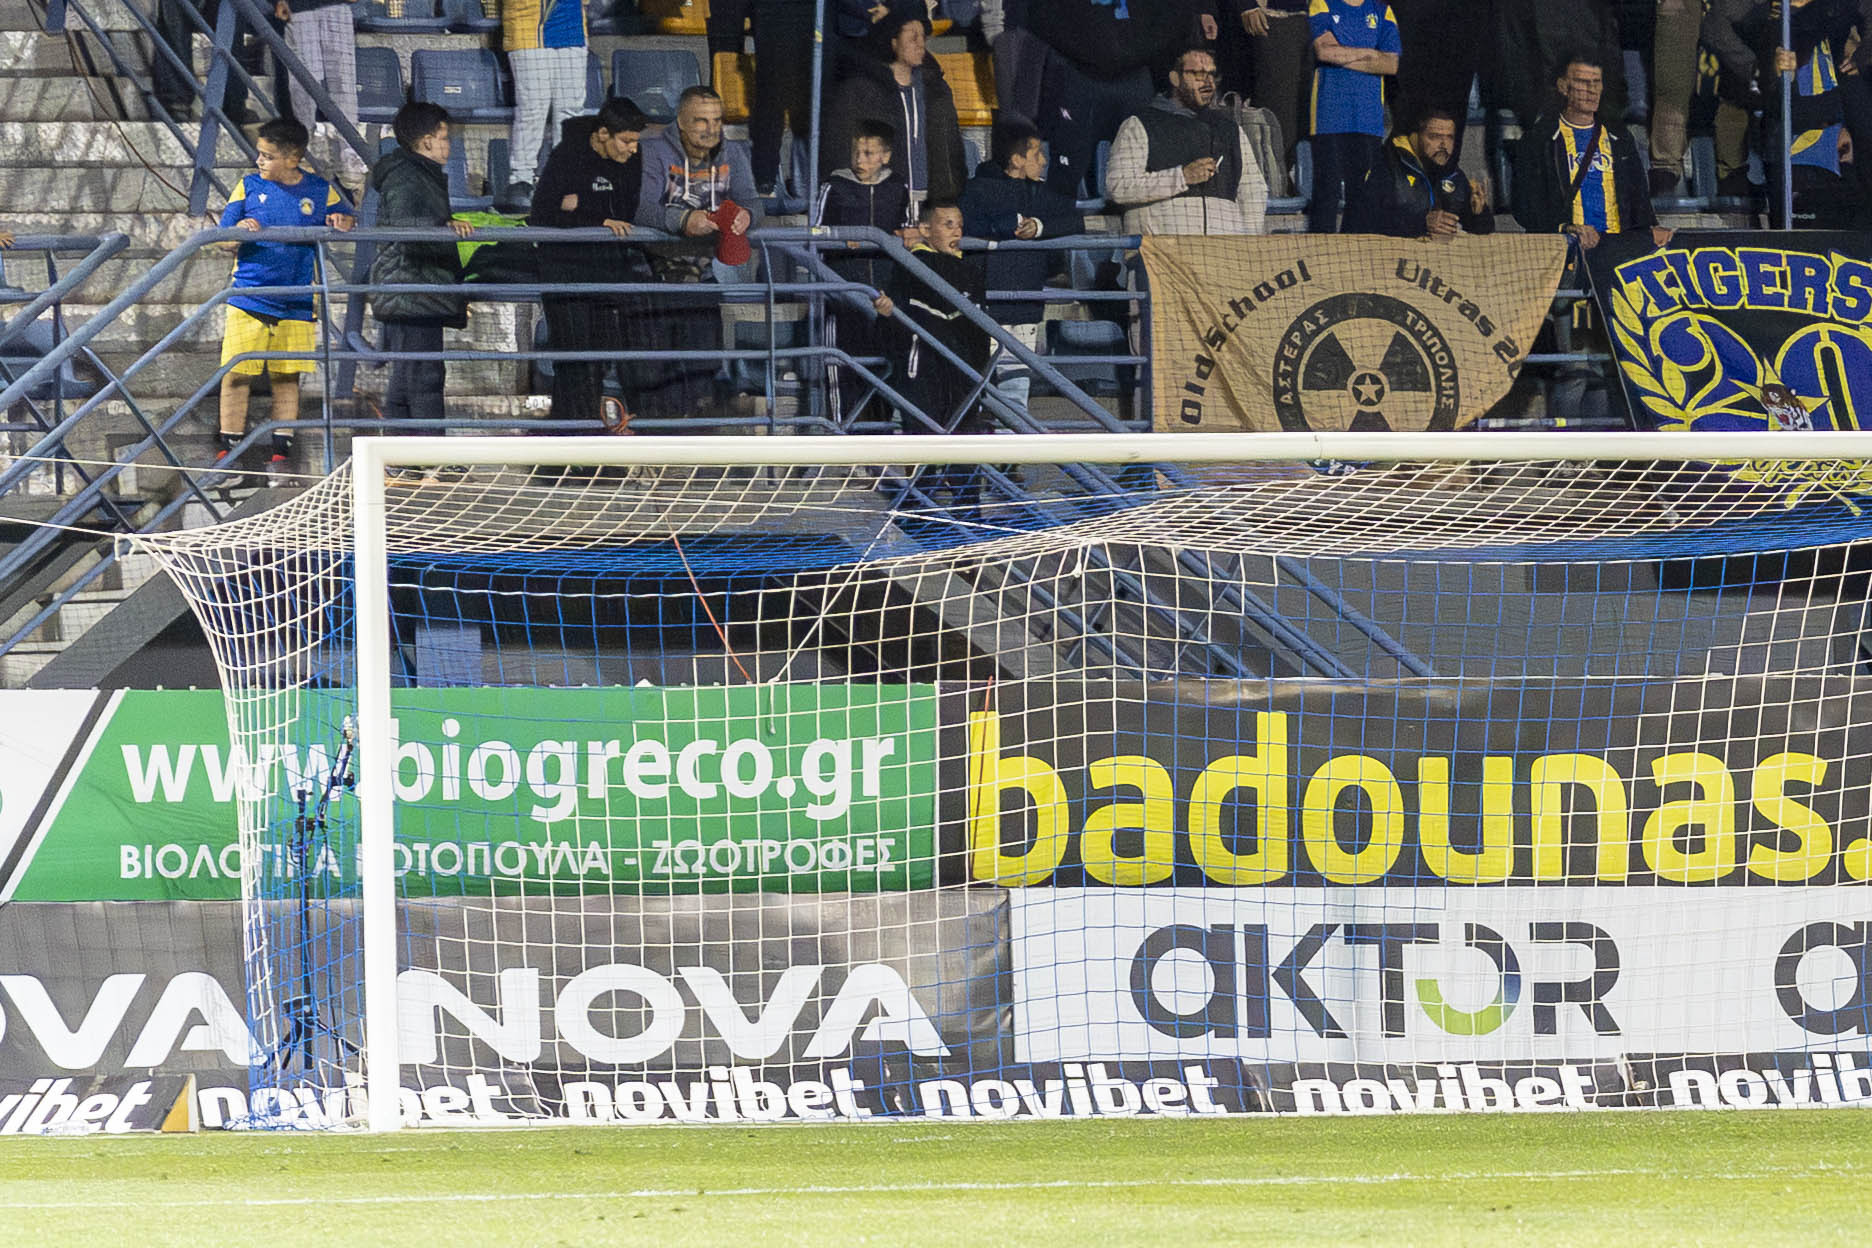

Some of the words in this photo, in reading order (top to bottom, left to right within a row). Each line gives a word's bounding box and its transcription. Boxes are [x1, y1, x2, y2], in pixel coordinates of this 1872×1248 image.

[1394, 257, 1498, 338] Ultras
[357, 838, 609, 878] ΟΤΟΠΟΥΛΑ
[652, 838, 896, 875] ΖΩΟΤΡΟΦΕΣ
[0, 971, 270, 1070] VA
[397, 962, 951, 1065] NOVA
[562, 1064, 873, 1120] novibet
[918, 1061, 1229, 1117] novibet
[1291, 1063, 1600, 1114] novibet
